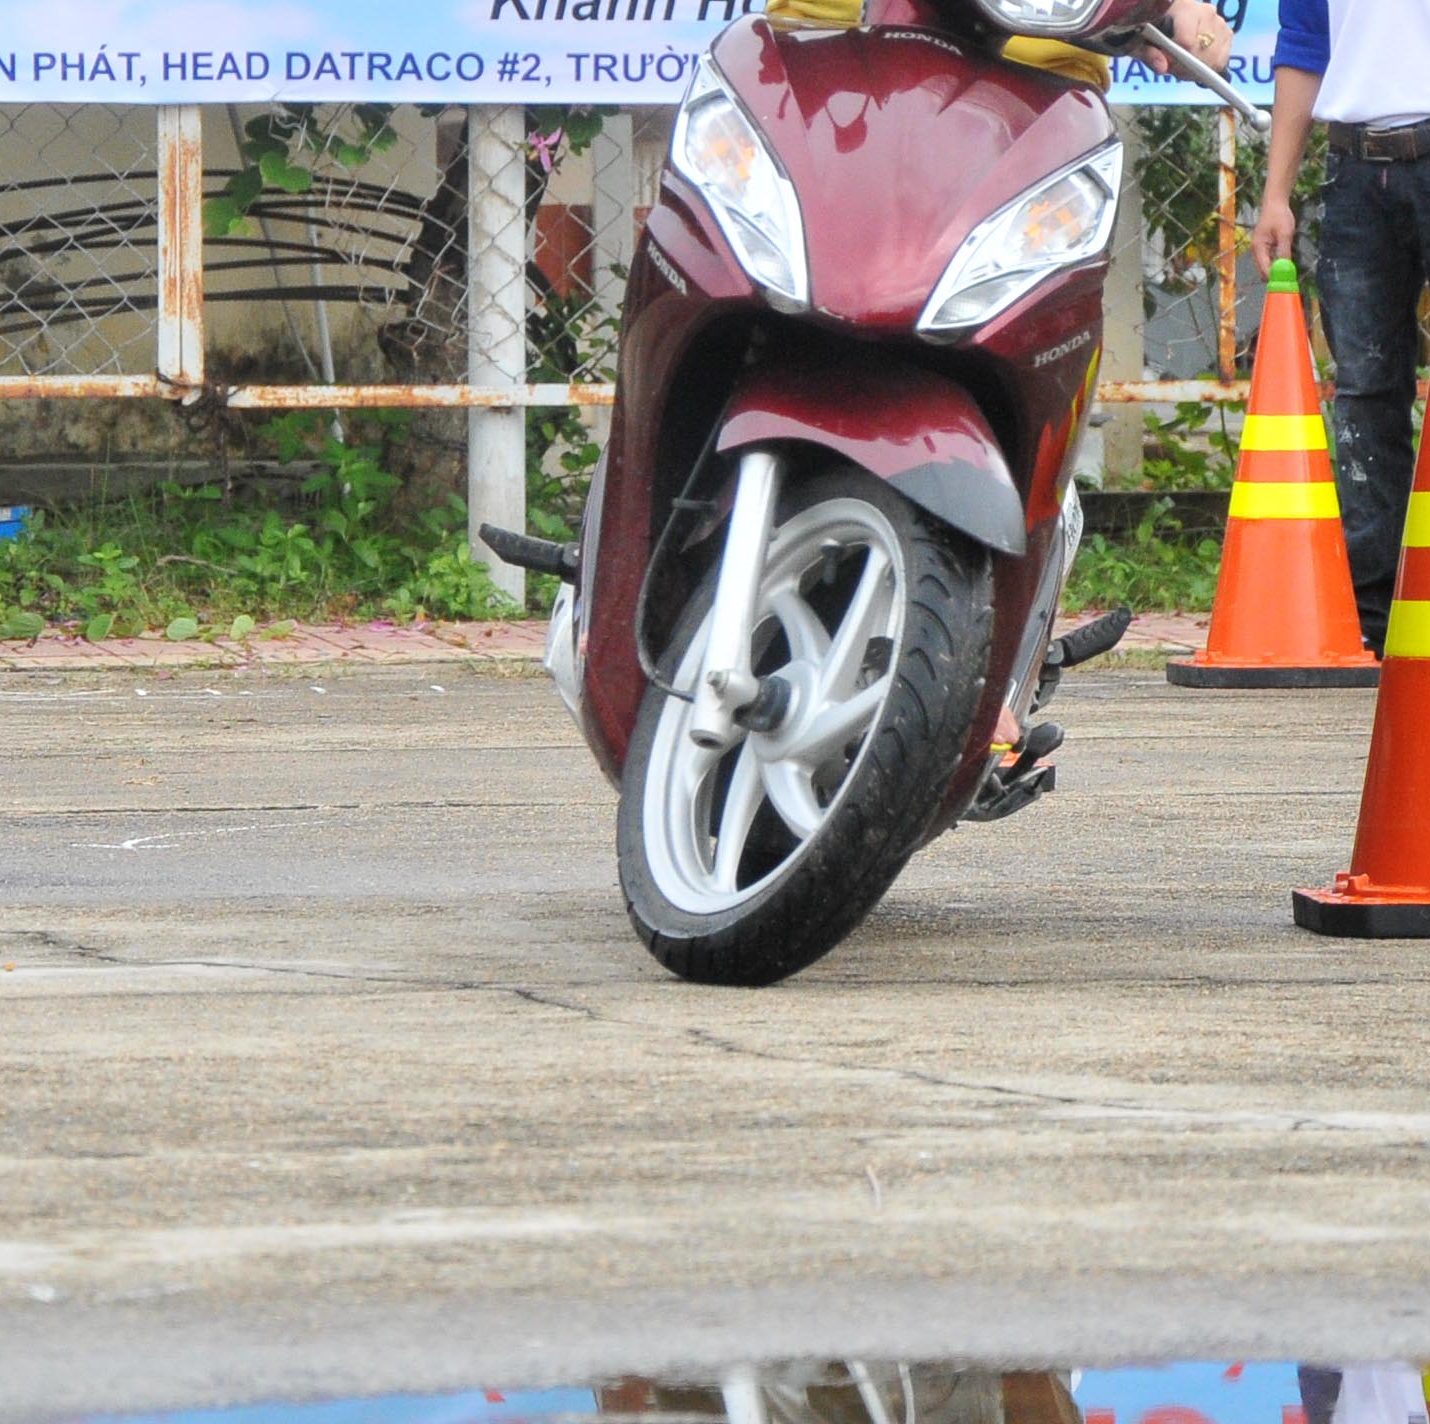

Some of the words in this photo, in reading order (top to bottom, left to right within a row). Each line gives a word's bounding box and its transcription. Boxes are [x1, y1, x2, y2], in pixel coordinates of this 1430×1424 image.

[883, 31, 964, 56] HONDA
[33, 44, 147, 87] PHÁT,
[162, 51, 270, 81] HEAD
[285, 51, 485, 82] DATRACO
[497, 51, 553, 87] #2,
[647, 239, 687, 296] HONDA
[1034, 330, 1091, 368] HONDA
